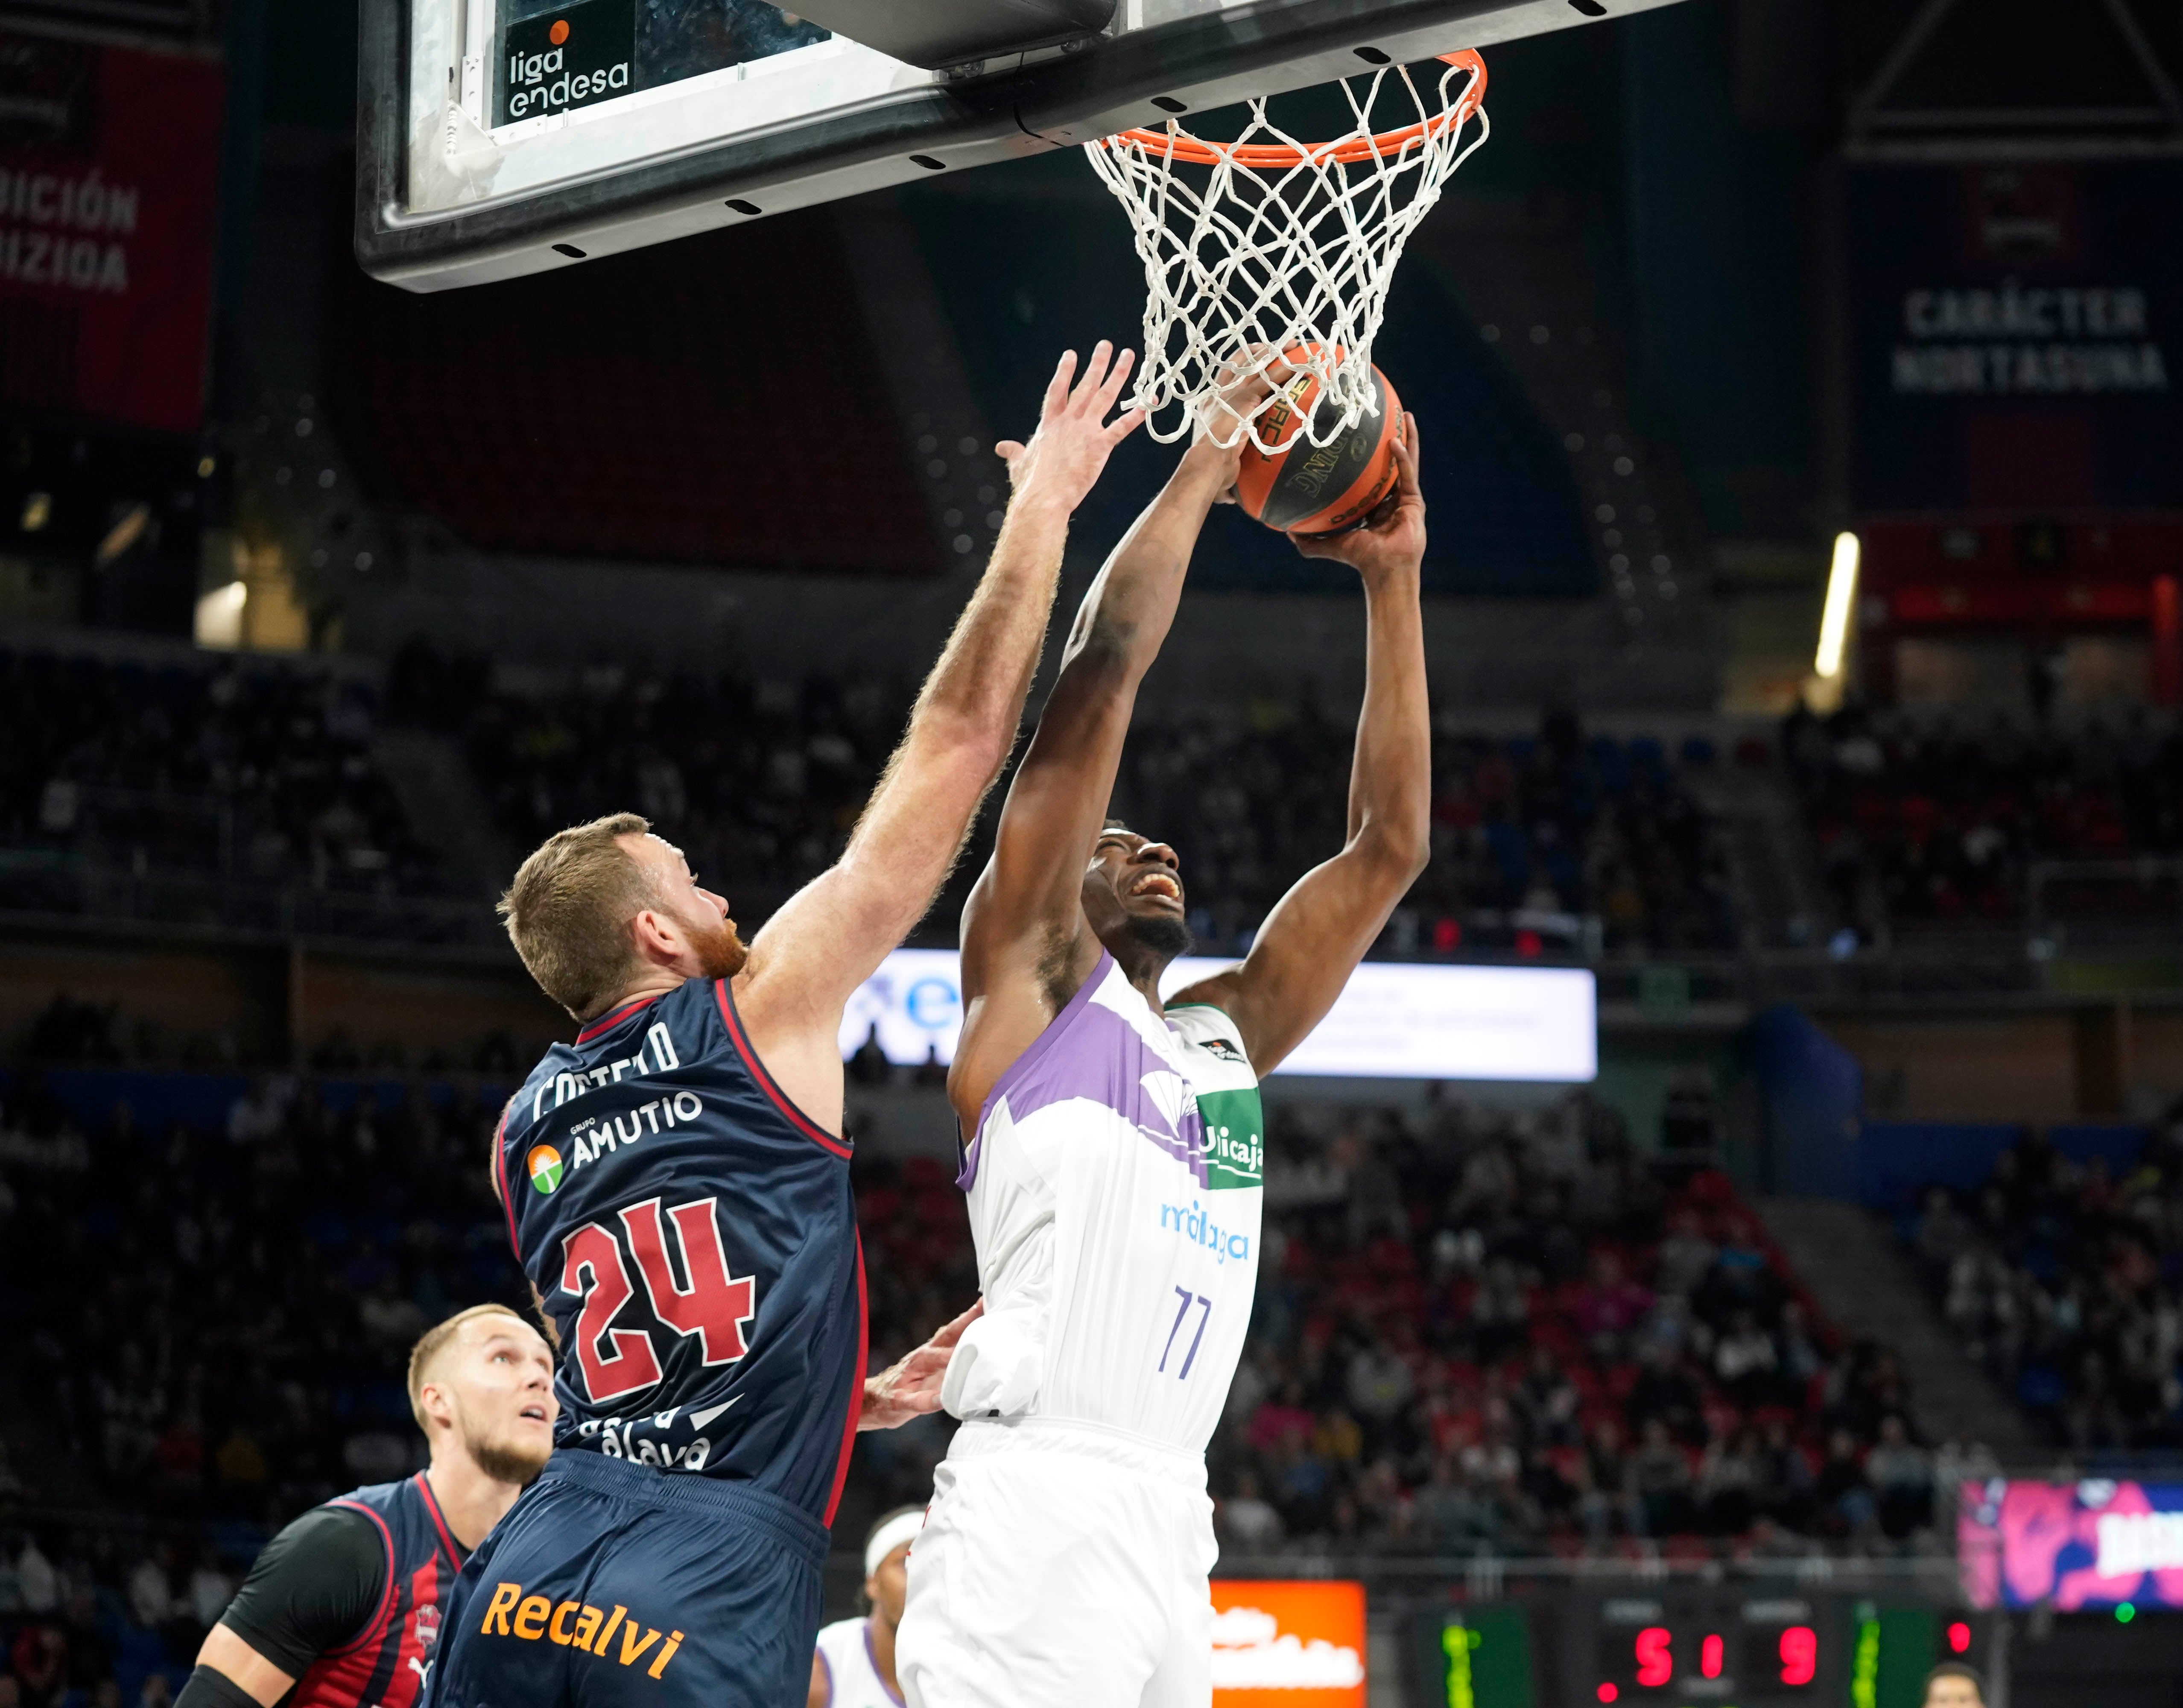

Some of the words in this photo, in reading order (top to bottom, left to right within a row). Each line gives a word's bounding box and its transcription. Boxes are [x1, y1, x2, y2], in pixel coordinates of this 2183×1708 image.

[509, 62, 628, 117] endesa
[510, 47, 563, 85] liga
[0, 230, 129, 294] IZIOA
[570, 1117, 596, 1135] GRUPO
[573, 1091, 703, 1169] AMUTIO
[560, 1196, 756, 1404] 24
[1158, 1284, 1212, 1380] 77
[481, 1582, 686, 1680] Recalvi
